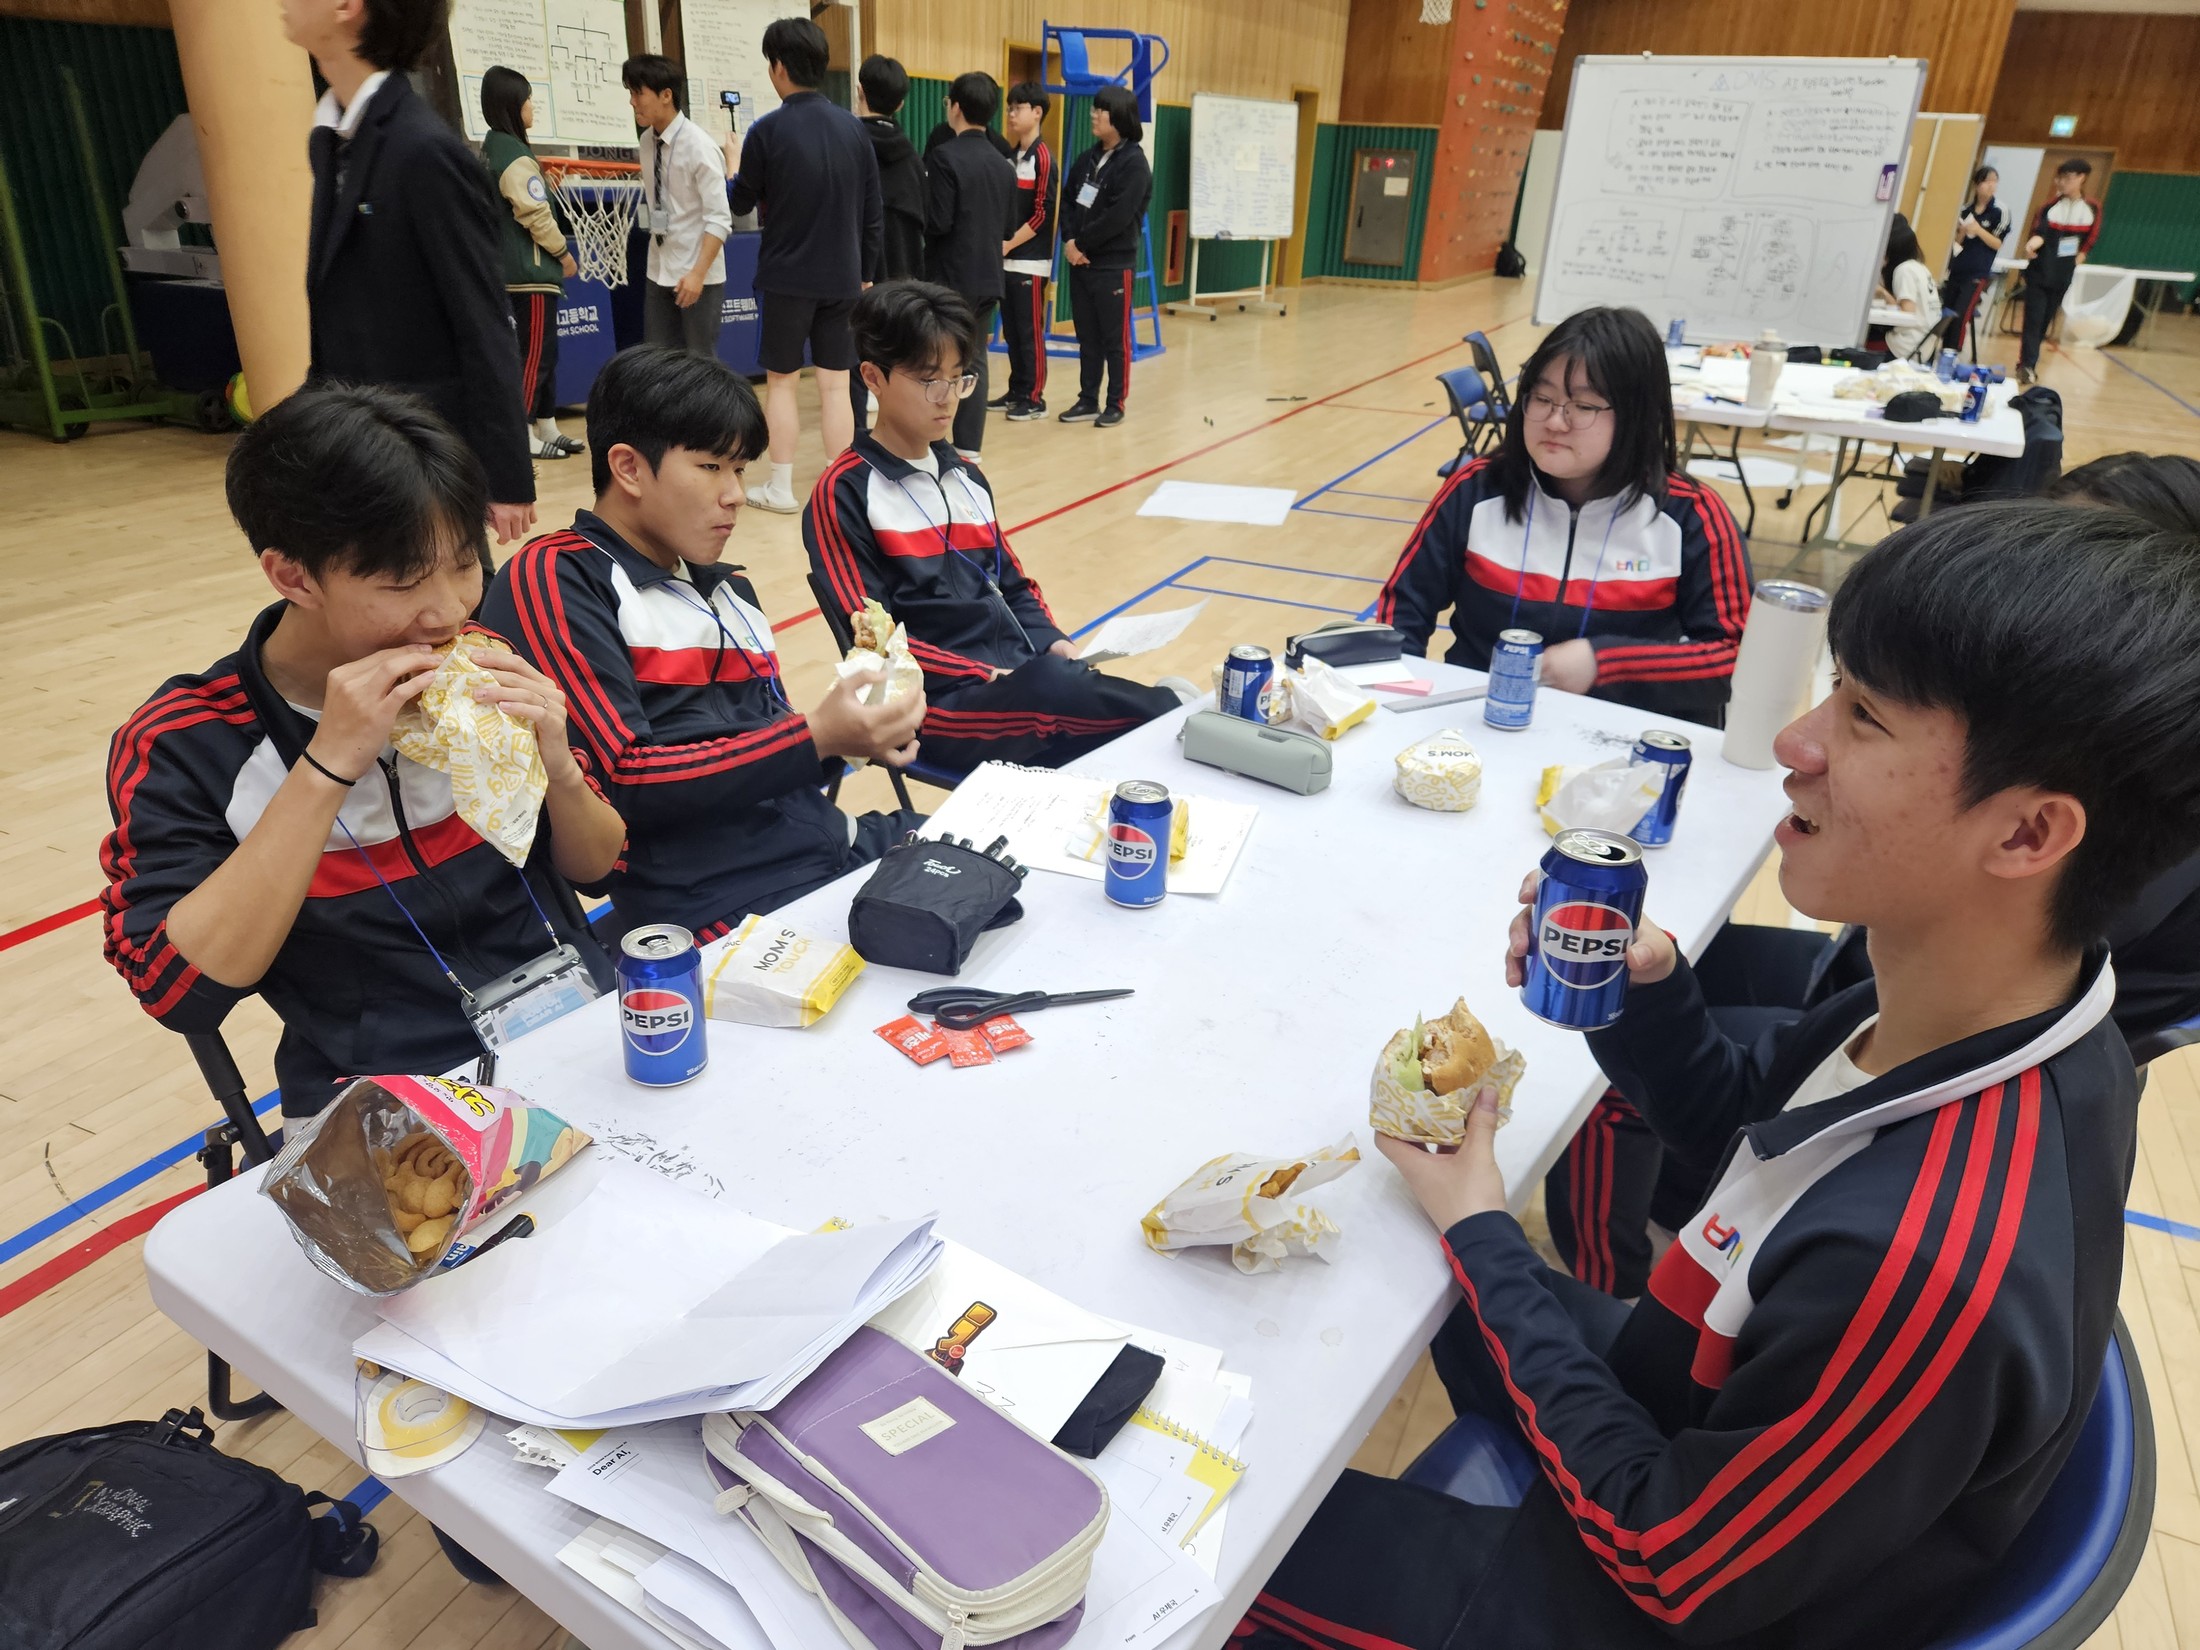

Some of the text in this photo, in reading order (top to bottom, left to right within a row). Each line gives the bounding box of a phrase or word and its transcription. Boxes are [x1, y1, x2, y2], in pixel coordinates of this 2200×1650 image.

[570, 324, 600, 336] SCHOOL
[753, 928, 796, 971] MOM'S
[623, 1008, 690, 1029] PEPSI
[881, 1411, 936, 1441] SPECIAL
[592, 1457, 616, 1476] Dear
[1159, 1599, 1178, 1615] 우체국
